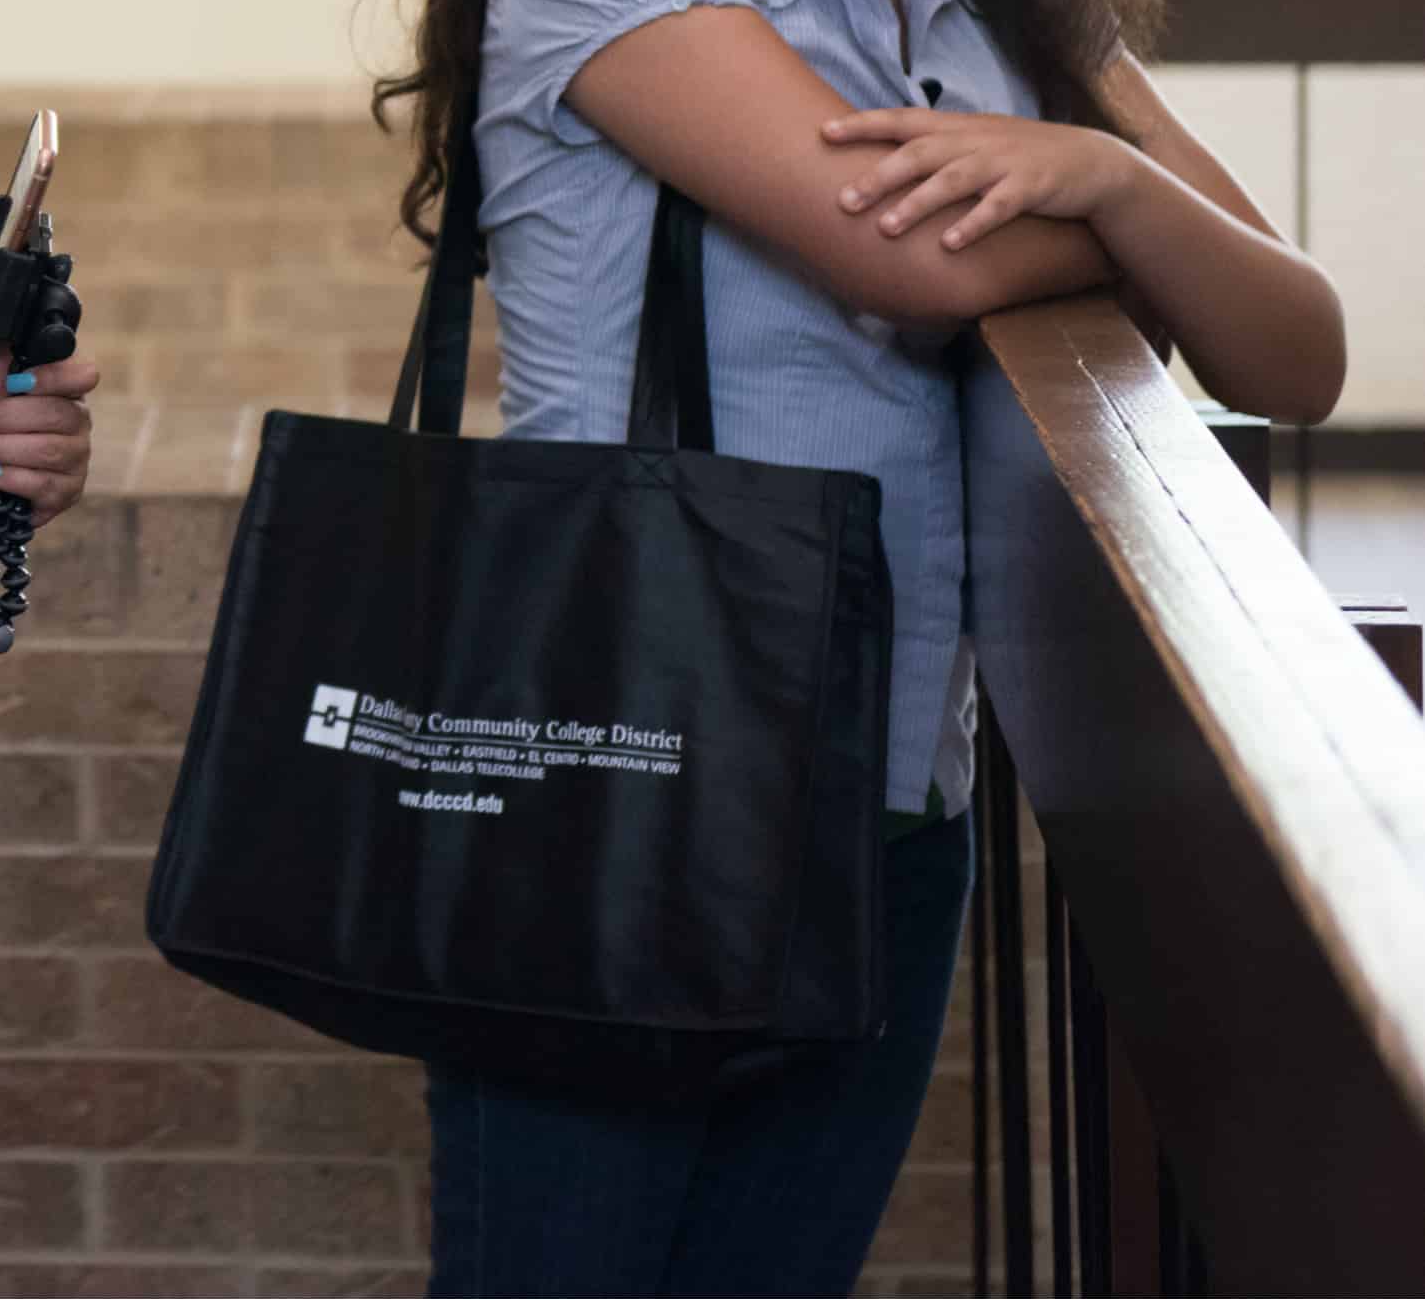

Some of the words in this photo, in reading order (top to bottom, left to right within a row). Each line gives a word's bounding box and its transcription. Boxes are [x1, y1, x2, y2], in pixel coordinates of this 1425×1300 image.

[427, 711, 542, 742] Community
[546, 720, 607, 746] College
[610, 724, 682, 751] District
[349, 740, 385, 759] NORTH
[430, 760, 474, 774] DALLAS
[462, 745, 517, 762] EASTFIELD
[528, 750, 540, 763] EL
[588, 753, 648, 772] MOUNTAIN
[650, 760, 681, 775] VIEW
